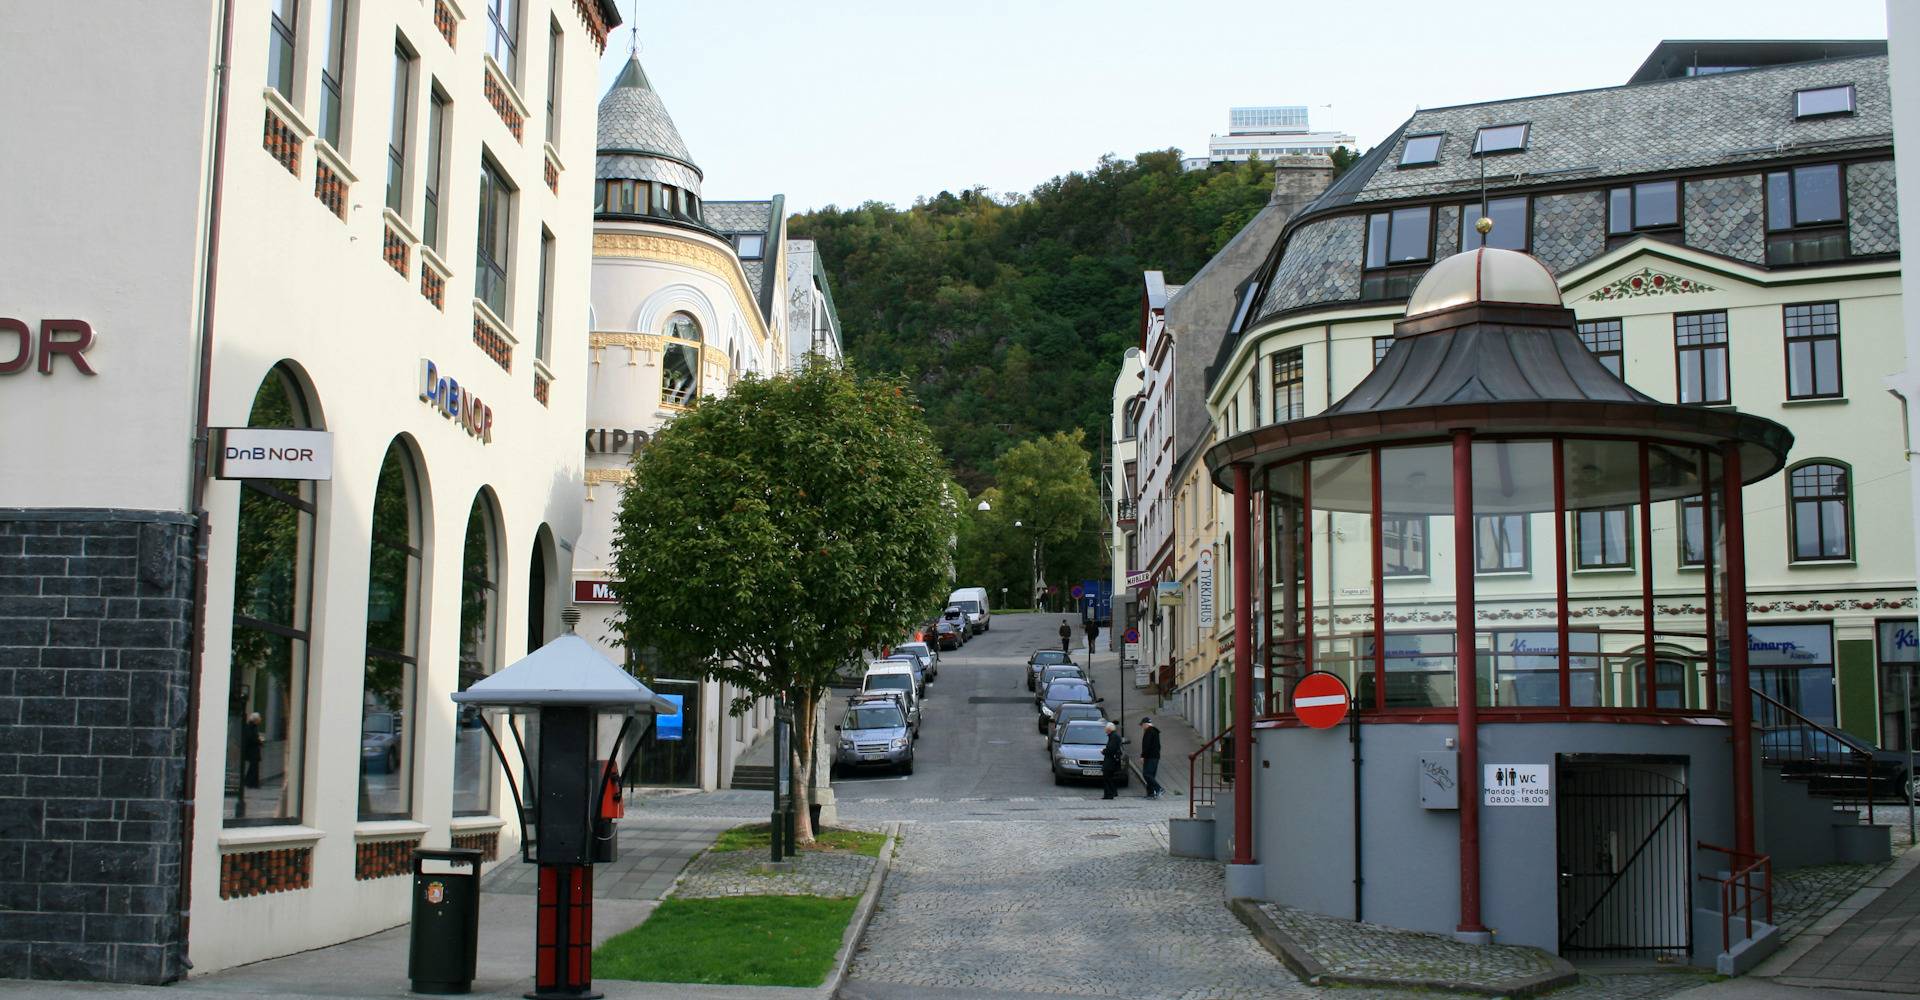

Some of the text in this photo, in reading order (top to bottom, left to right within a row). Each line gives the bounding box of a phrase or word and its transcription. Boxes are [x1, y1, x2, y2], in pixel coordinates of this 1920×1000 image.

[1126, 573, 1150, 585] MØBLER
[1201, 569, 1212, 623] TYRKIAHUS
[1748, 634, 1797, 654] innarps
[1519, 774, 1536, 783] WC
[1484, 788, 1515, 796] Mandag
[1521, 788, 1549, 796] Fredag
